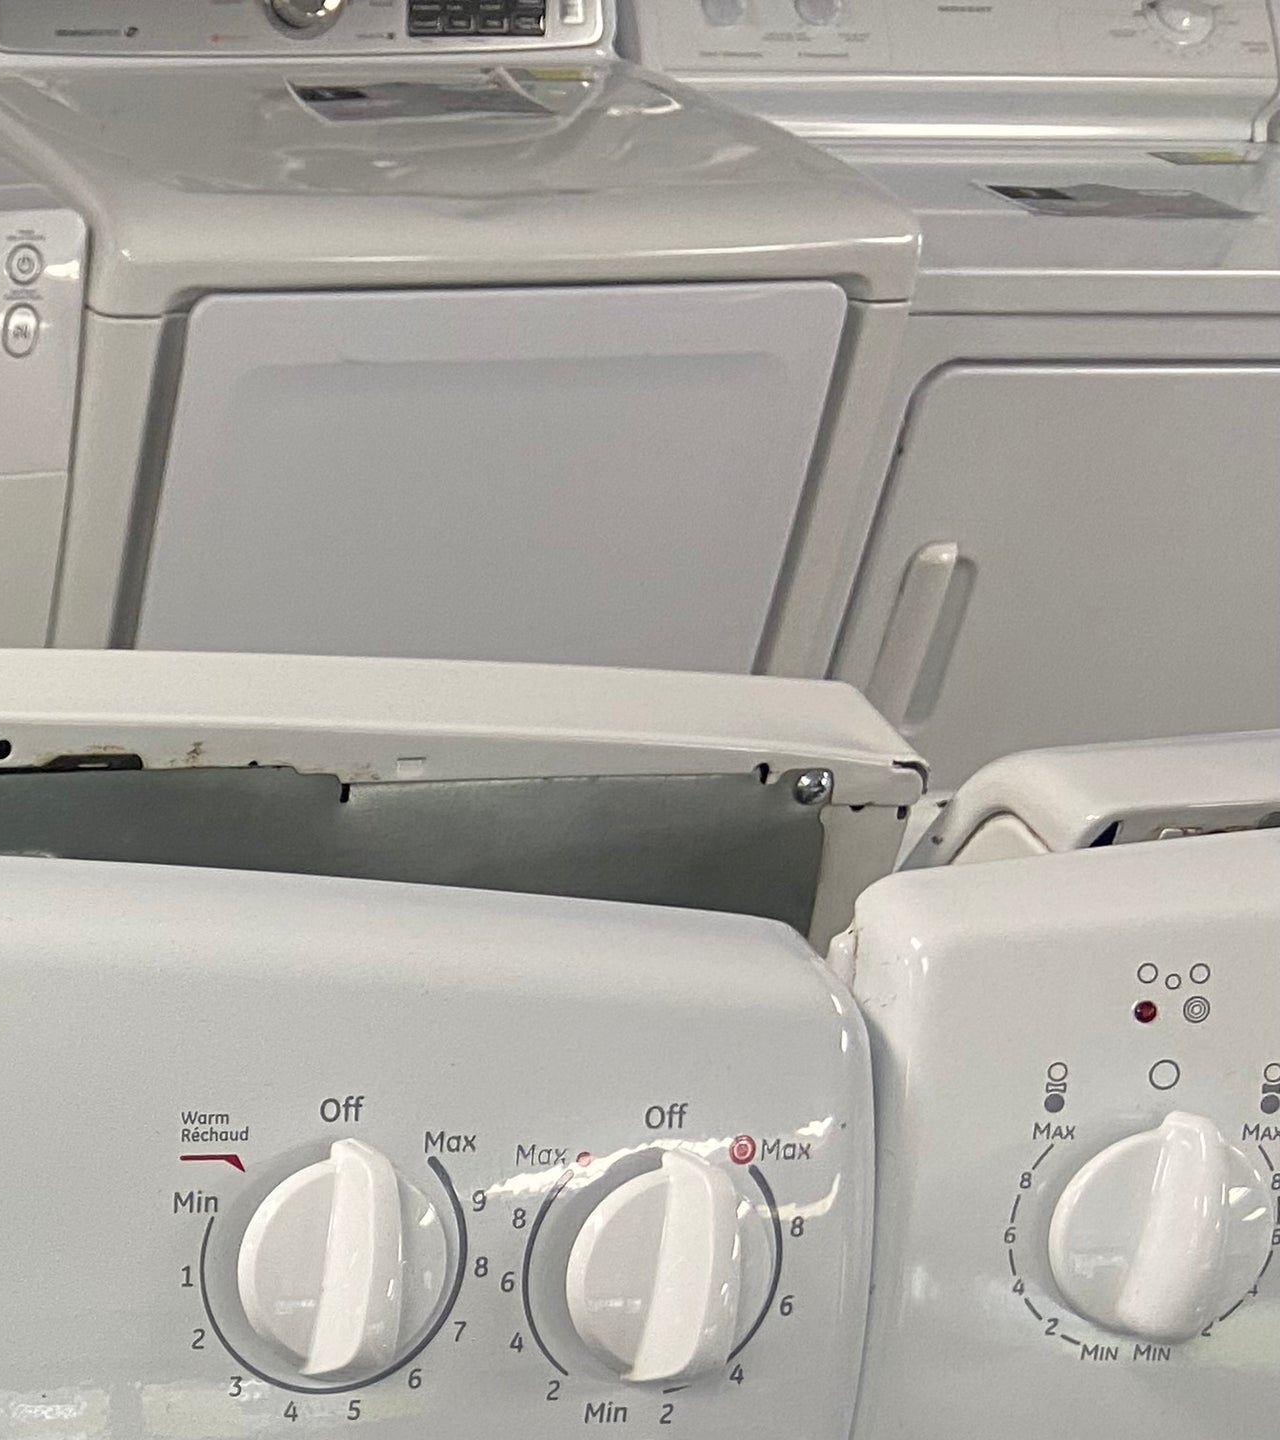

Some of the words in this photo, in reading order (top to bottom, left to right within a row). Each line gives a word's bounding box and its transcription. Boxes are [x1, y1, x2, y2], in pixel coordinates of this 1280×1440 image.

[181, 1110, 230, 1126] Warm
[319, 1095, 365, 1123] Off
[644, 1102, 689, 1130] Off
[181, 1125, 249, 1143] Réchaud
[424, 1130, 477, 1154] Max
[1032, 1122, 1076, 1141] MAX
[515, 1144, 567, 1166] Max
[760, 1138, 811, 1162] Max
[1019, 1171, 1032, 1190] 8
[173, 1190, 219, 1214] Min
[472, 1189, 488, 1213] 9
[512, 1207, 527, 1230] 8
[790, 1216, 805, 1238] 8
[1003, 1226, 1017, 1244] 6
[181, 1265, 194, 1288] 1
[473, 1256, 489, 1279] 8
[500, 1270, 515, 1293] 6
[1012, 1277, 1025, 1296] 4
[779, 1294, 795, 1317] 6
[453, 1320, 467, 1343] 7
[1044, 1317, 1060, 1336] 2
[191, 1328, 206, 1350] 2
[509, 1331, 524, 1353] 4
[1080, 1343, 1119, 1362] MIN
[1133, 1342, 1174, 1362] MIN
[407, 1368, 423, 1390] 6
[729, 1363, 745, 1385] 4
[228, 1375, 244, 1398] 3
[546, 1380, 561, 1401] 2
[283, 1400, 299, 1423] 4
[346, 1399, 362, 1421] 5
[584, 1401, 628, 1425] Min
[659, 1403, 674, 1425] 2
